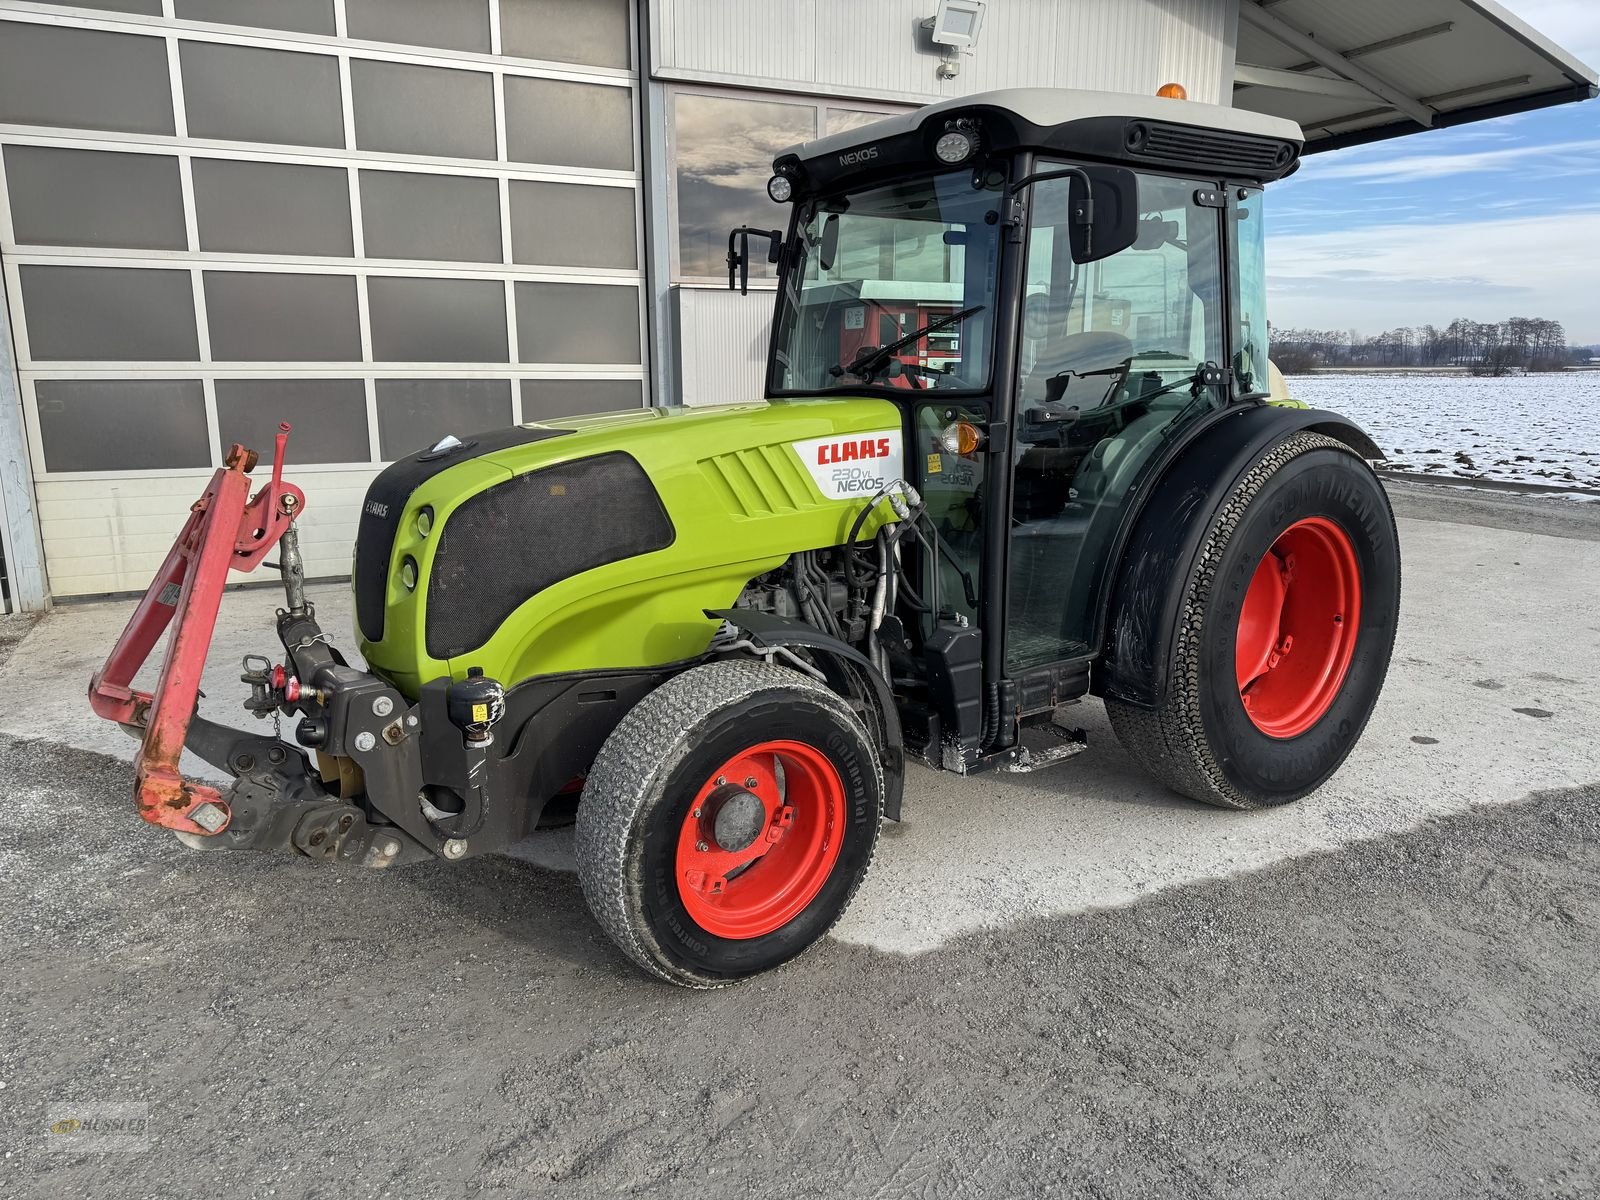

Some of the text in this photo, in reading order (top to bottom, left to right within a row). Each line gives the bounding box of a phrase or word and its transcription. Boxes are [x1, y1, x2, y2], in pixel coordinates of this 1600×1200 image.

[839, 146, 878, 166] NEXOS
[817, 438, 889, 465] CLAAS
[832, 467, 861, 481] 230
[837, 477, 884, 493] NEXOS
[366, 500, 388, 517] CLAAS
